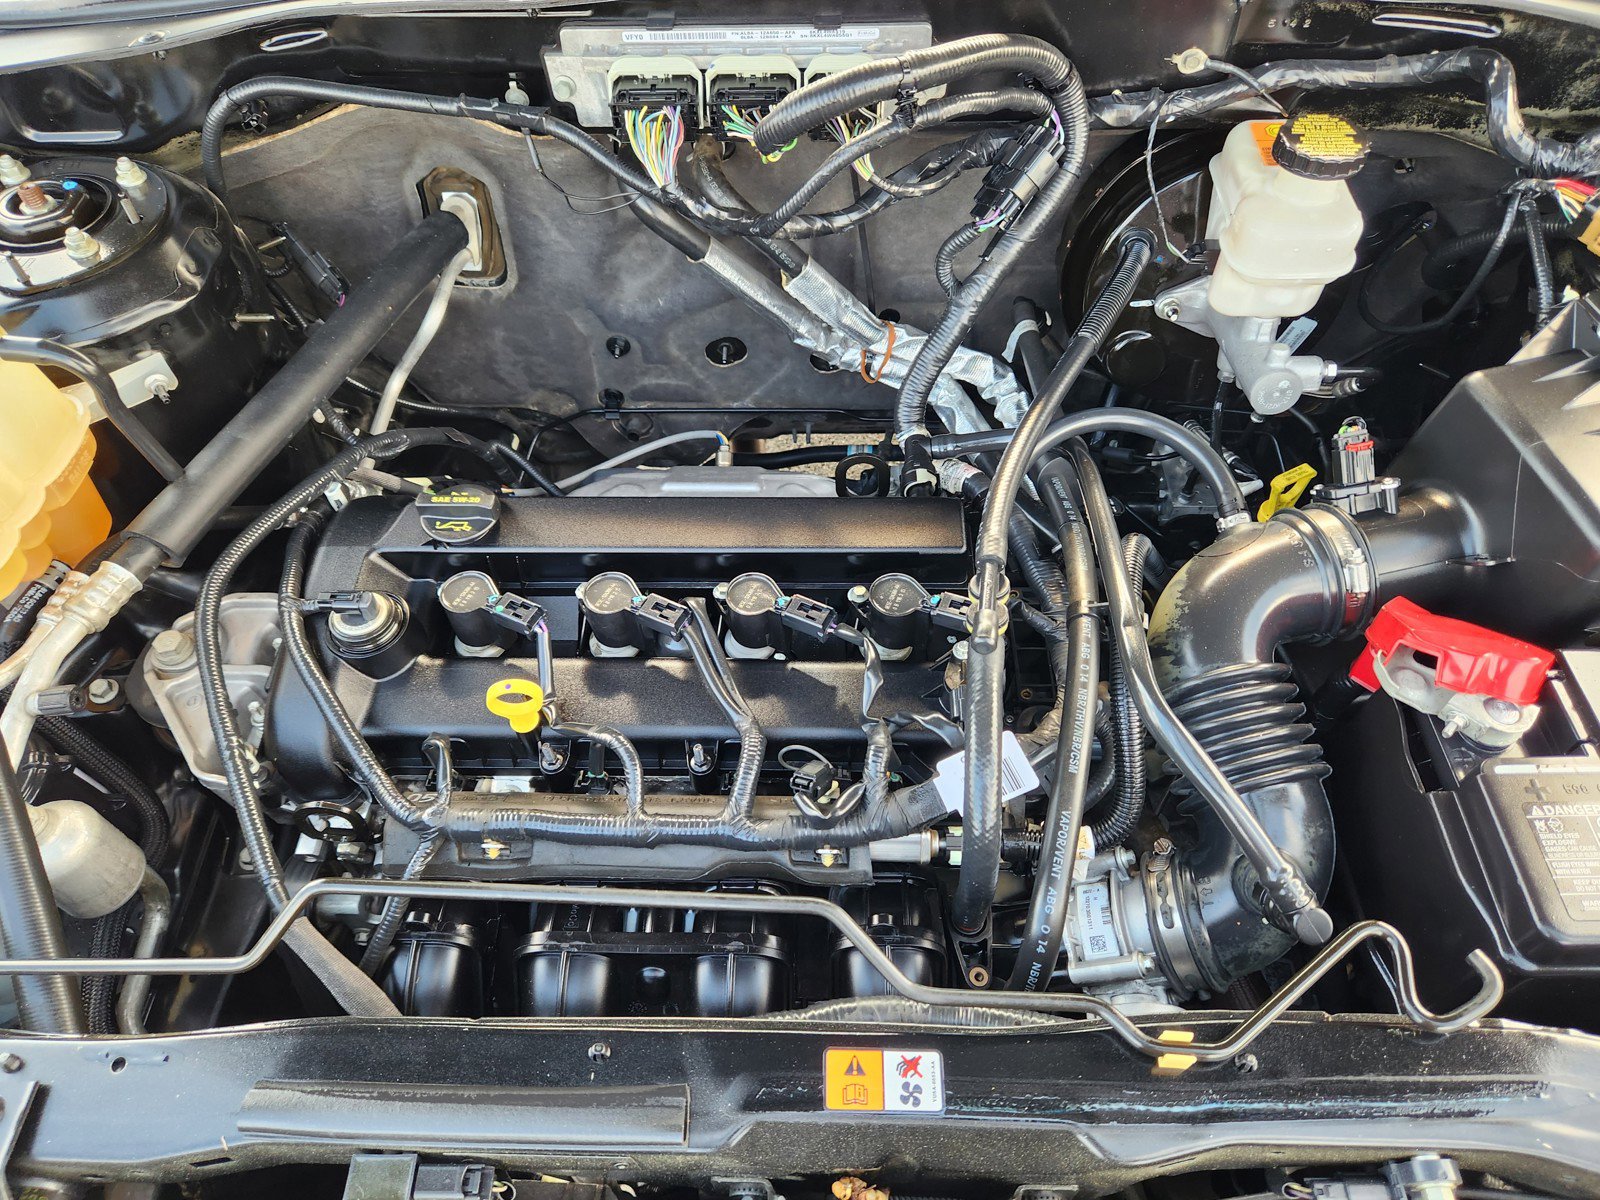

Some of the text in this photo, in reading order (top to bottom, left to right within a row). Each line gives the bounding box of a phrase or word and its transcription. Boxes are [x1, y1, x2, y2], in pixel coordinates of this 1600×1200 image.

[1081, 642, 1091, 659] ABG
[1051, 809, 1071, 880] VAPOR/VENT
[1045, 886, 1057, 914] ABG
[1036, 940, 1046, 954] 14
